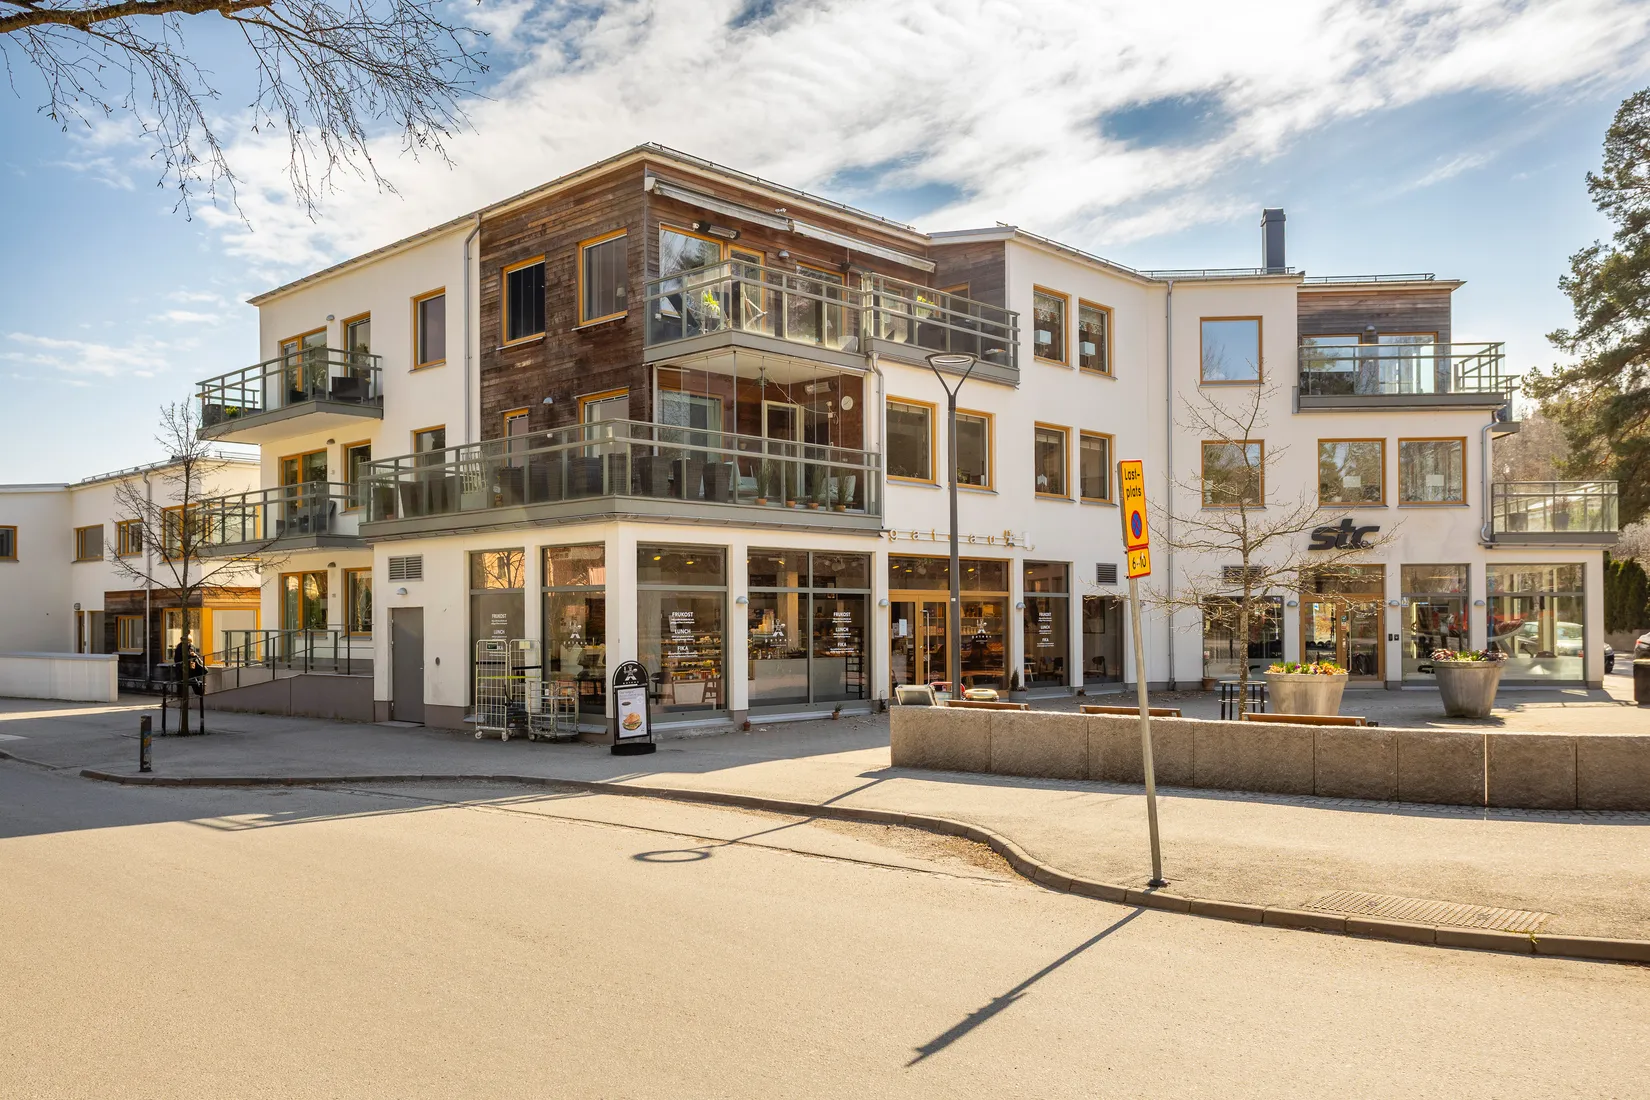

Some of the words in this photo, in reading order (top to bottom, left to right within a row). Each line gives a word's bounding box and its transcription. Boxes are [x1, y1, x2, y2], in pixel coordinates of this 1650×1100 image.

[1124, 468, 1140, 480] Last-
[1126, 485, 1142, 500] plats
[888, 528, 995, 546] gatau
[1308, 518, 1380, 550] stc
